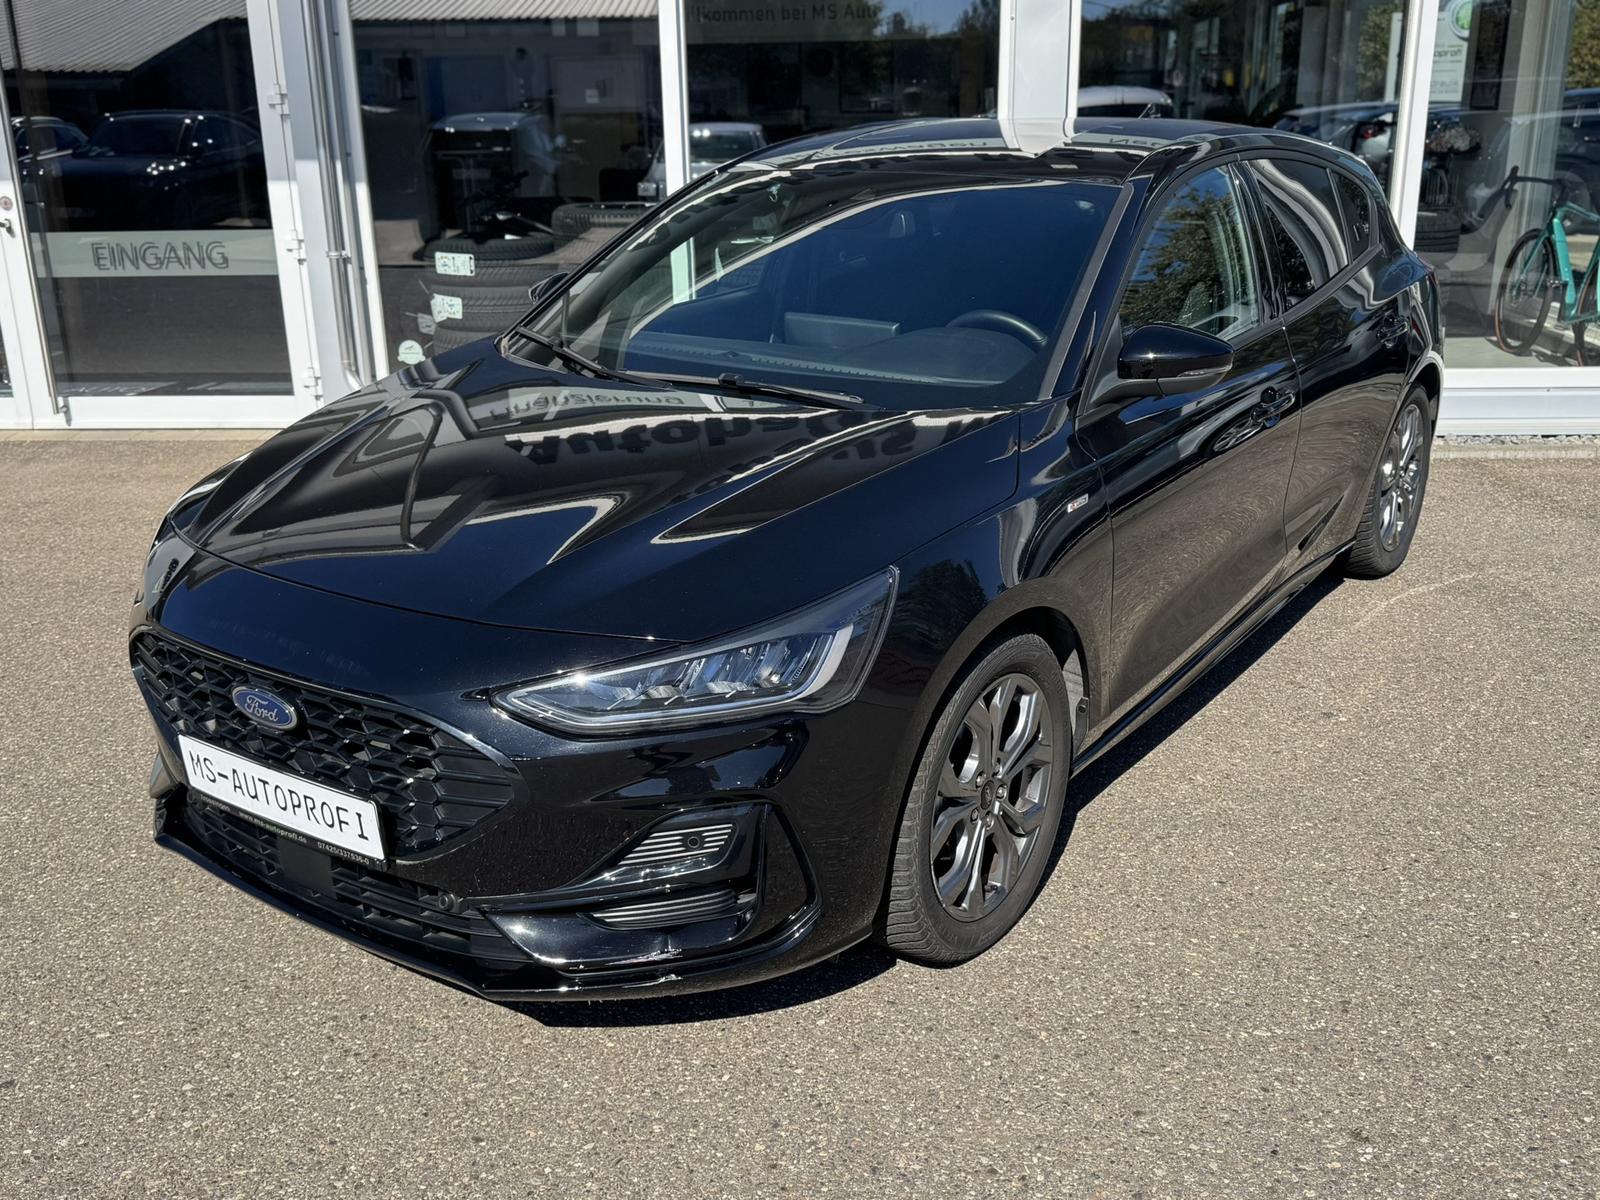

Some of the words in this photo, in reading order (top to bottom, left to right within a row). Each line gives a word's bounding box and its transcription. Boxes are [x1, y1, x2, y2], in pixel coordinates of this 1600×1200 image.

[689, 5, 775, 22] llkommen
[781, 6, 806, 20] bei
[811, 4, 838, 20] MS
[91, 240, 229, 271] EINGANG
[245, 694, 279, 722] Ford
[188, 750, 369, 842] MS-AUTOPROFI
